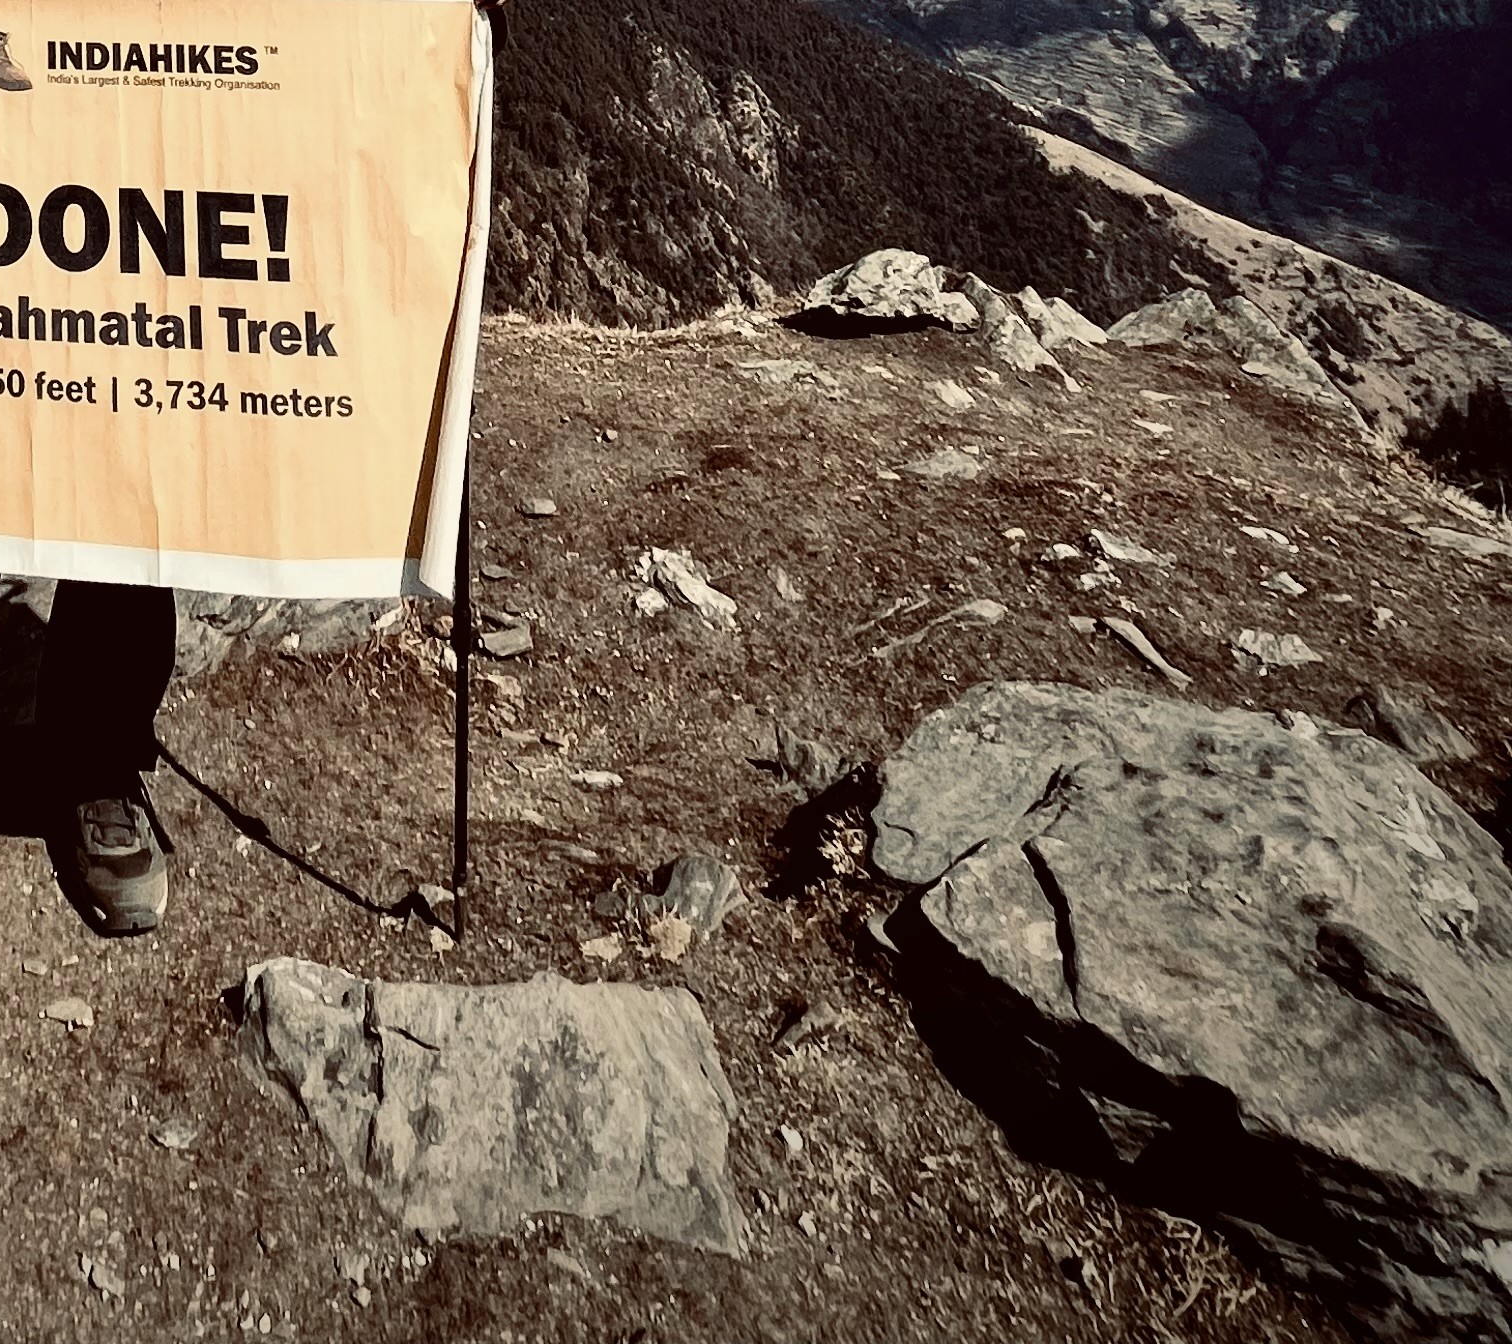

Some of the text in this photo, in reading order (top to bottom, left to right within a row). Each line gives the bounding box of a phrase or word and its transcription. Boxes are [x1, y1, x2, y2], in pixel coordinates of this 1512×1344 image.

[47, 40, 259, 75] INDIAHIKES
[47, 73, 281, 91] India's Largest & Safest Trekking Organisation
[218, 306, 338, 357] Trek
[34, 370, 97, 404] feet
[134, 377, 229, 415] 3,734
[240, 388, 353, 418] meters
